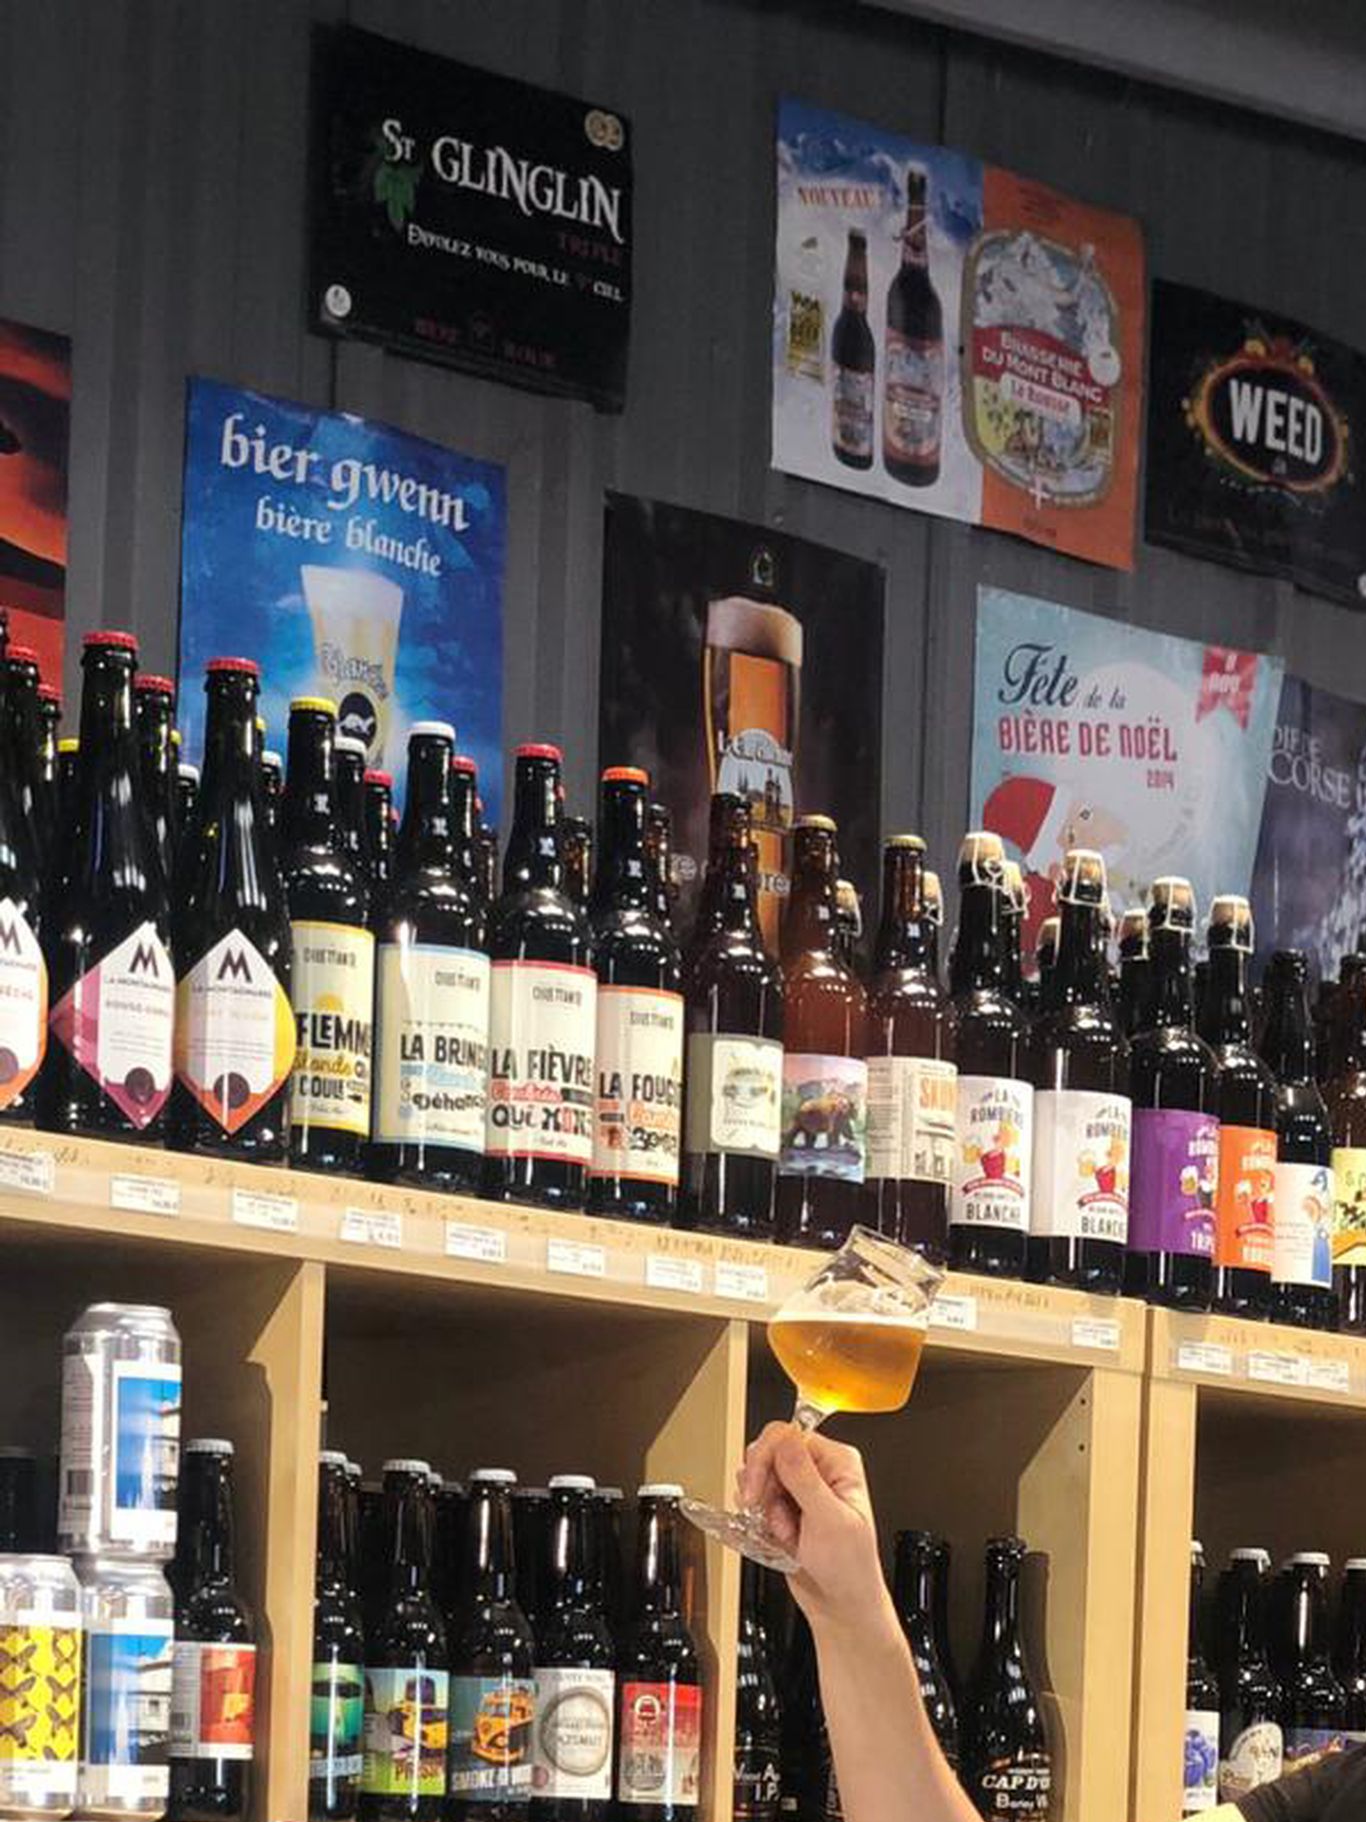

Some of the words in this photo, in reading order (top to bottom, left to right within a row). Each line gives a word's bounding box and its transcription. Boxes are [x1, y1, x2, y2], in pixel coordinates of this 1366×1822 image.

[431, 136, 624, 244] GLINGLIN
[1229, 377, 1323, 466] WEED
[221, 413, 318, 483] bier
[327, 458, 470, 532] gwenn
[256, 496, 331, 543] bière
[345, 515, 442, 577] blanche
[999, 708, 1071, 755] BIÈRE
[1079, 720, 1112, 756] DE
[1119, 716, 1178, 761] NOËL
[1268, 749, 1351, 810] CORSE
[128, 942, 160, 978] M
[217, 948, 253, 985] M
[401, 1033, 425, 1062] LA
[491, 1048, 518, 1080] LA
[600, 1072, 623, 1100] LA
[981, 1774, 1025, 1791] CAP
